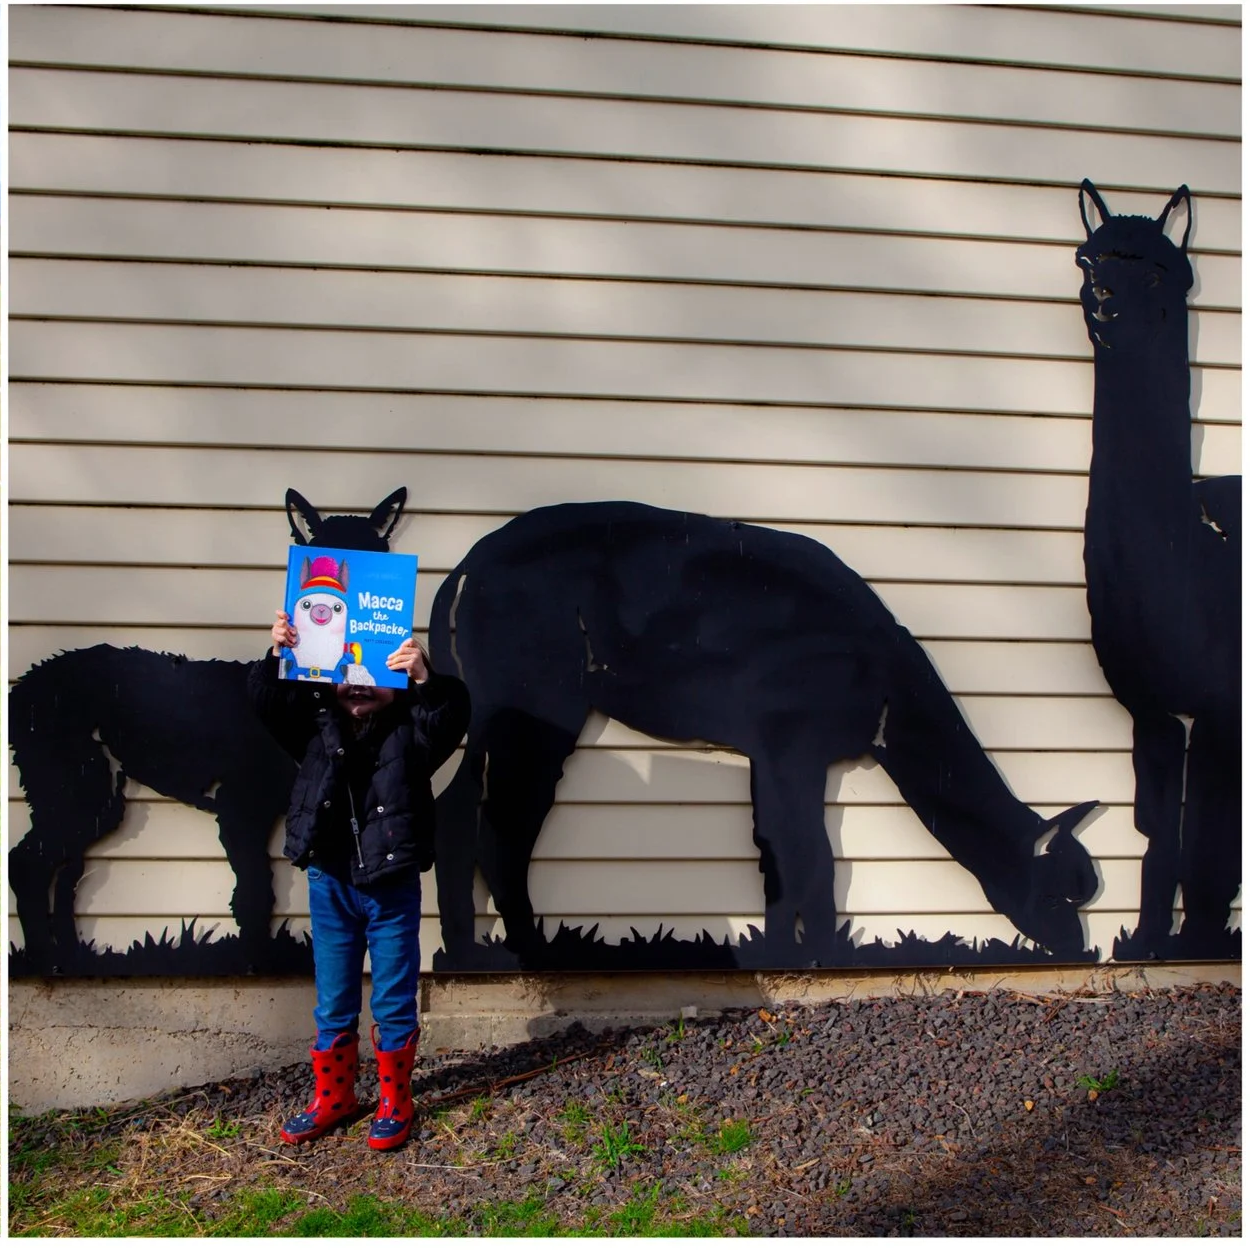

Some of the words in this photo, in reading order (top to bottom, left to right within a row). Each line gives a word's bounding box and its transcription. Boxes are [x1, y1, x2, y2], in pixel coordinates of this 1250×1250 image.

[358, 591, 403, 611] Macca
[373, 611, 389, 621] the
[350, 619, 409, 637] Backpacker
